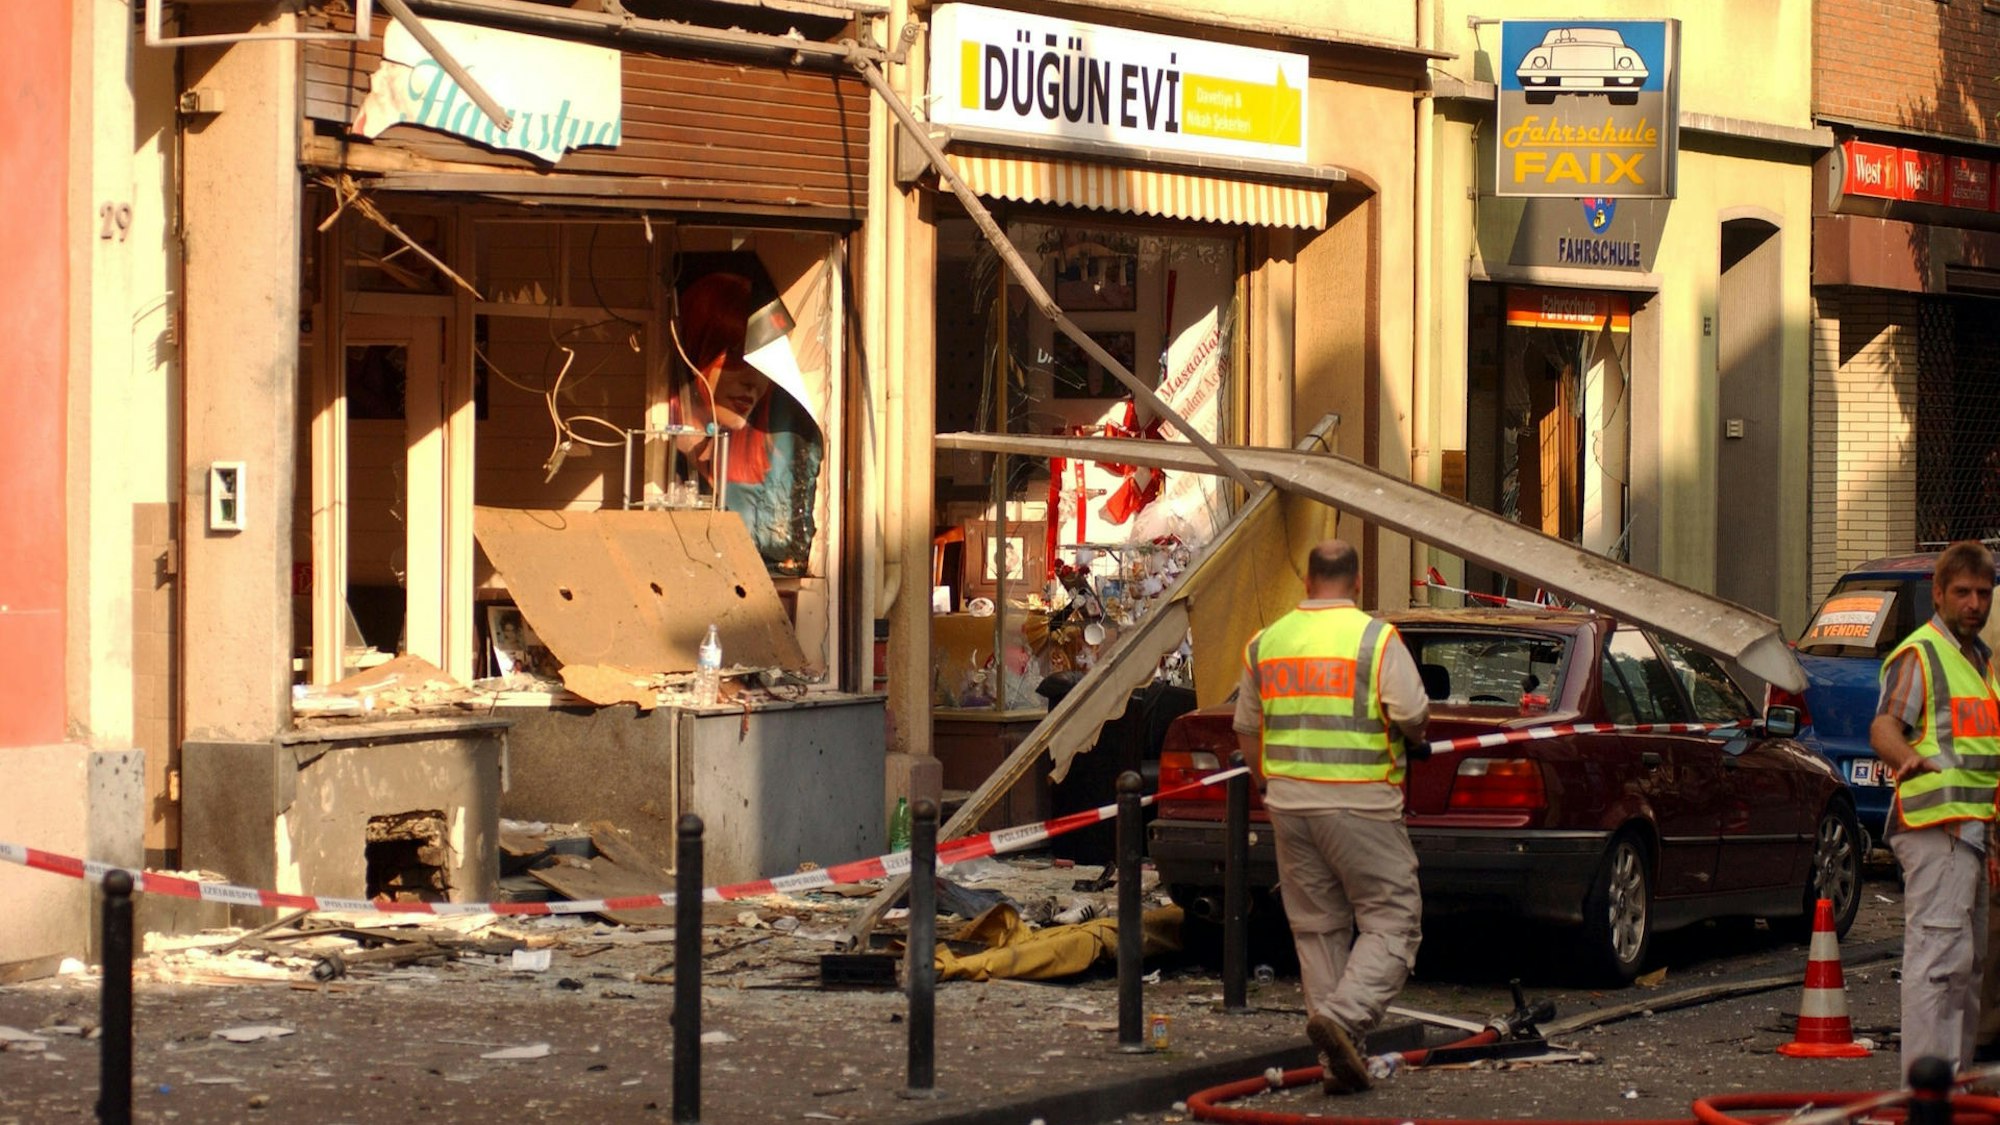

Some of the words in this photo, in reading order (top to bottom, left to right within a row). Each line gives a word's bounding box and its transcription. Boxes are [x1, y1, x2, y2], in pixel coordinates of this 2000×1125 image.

[1503, 115, 1657, 149] Fahrschule
[1514, 152, 1646, 184] FAIX
[1855, 154, 1882, 184] West
[1905, 161, 1930, 191] West
[100, 201, 132, 243] 29
[1559, 238, 1640, 267] FAHRSCHULE
[1541, 295, 1596, 323] Fahrschule
[1823, 624, 1872, 638] VENDRE
[1261, 661, 1349, 695] POLIZEI
